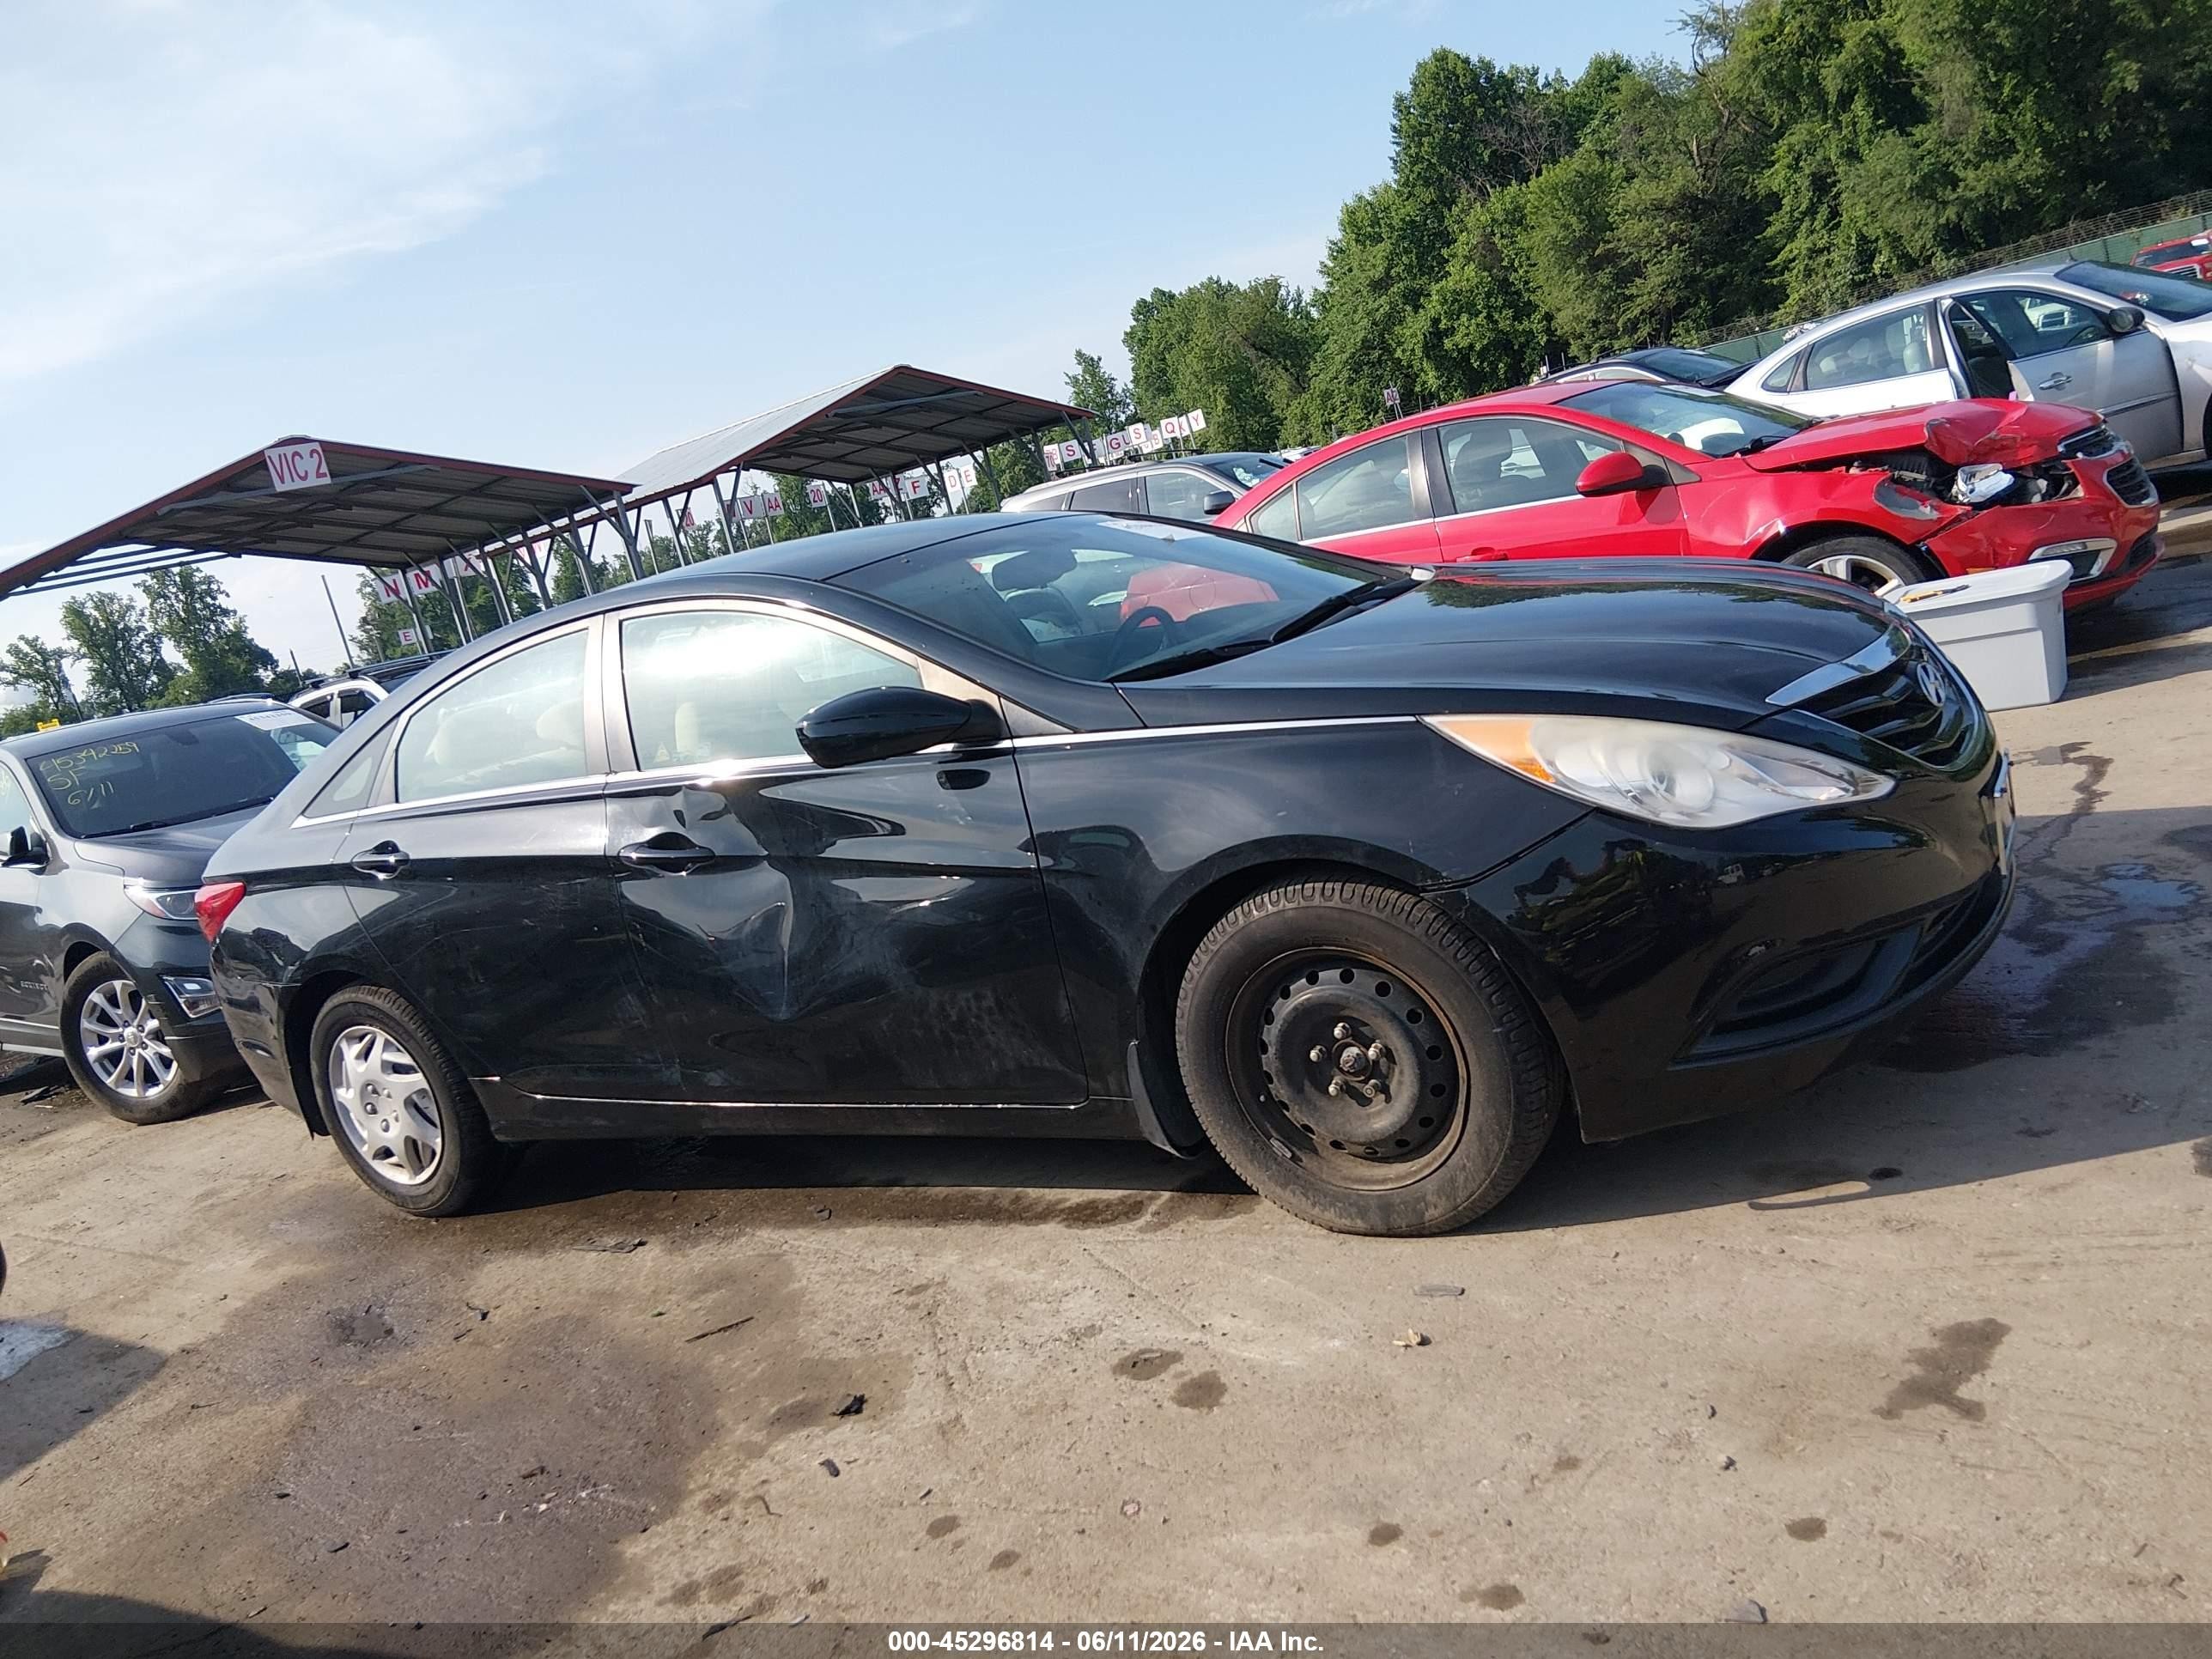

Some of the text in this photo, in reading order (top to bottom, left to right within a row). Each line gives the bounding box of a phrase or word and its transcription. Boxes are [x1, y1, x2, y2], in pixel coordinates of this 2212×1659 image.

[1133, 428, 1142, 440] S
[1164, 422, 1176, 434] Q
[1109, 437, 1121, 450] G
[1065, 444, 1076, 457] S
[268, 448, 328, 484] VIC 2
[964, 469, 973, 483] E
[911, 480, 921, 495] F
[810, 489, 824, 503] 20
[743, 500, 754, 515] V
[768, 500, 782, 513] AA
[384, 578, 402, 599] N
[403, 631, 413, 642] E
